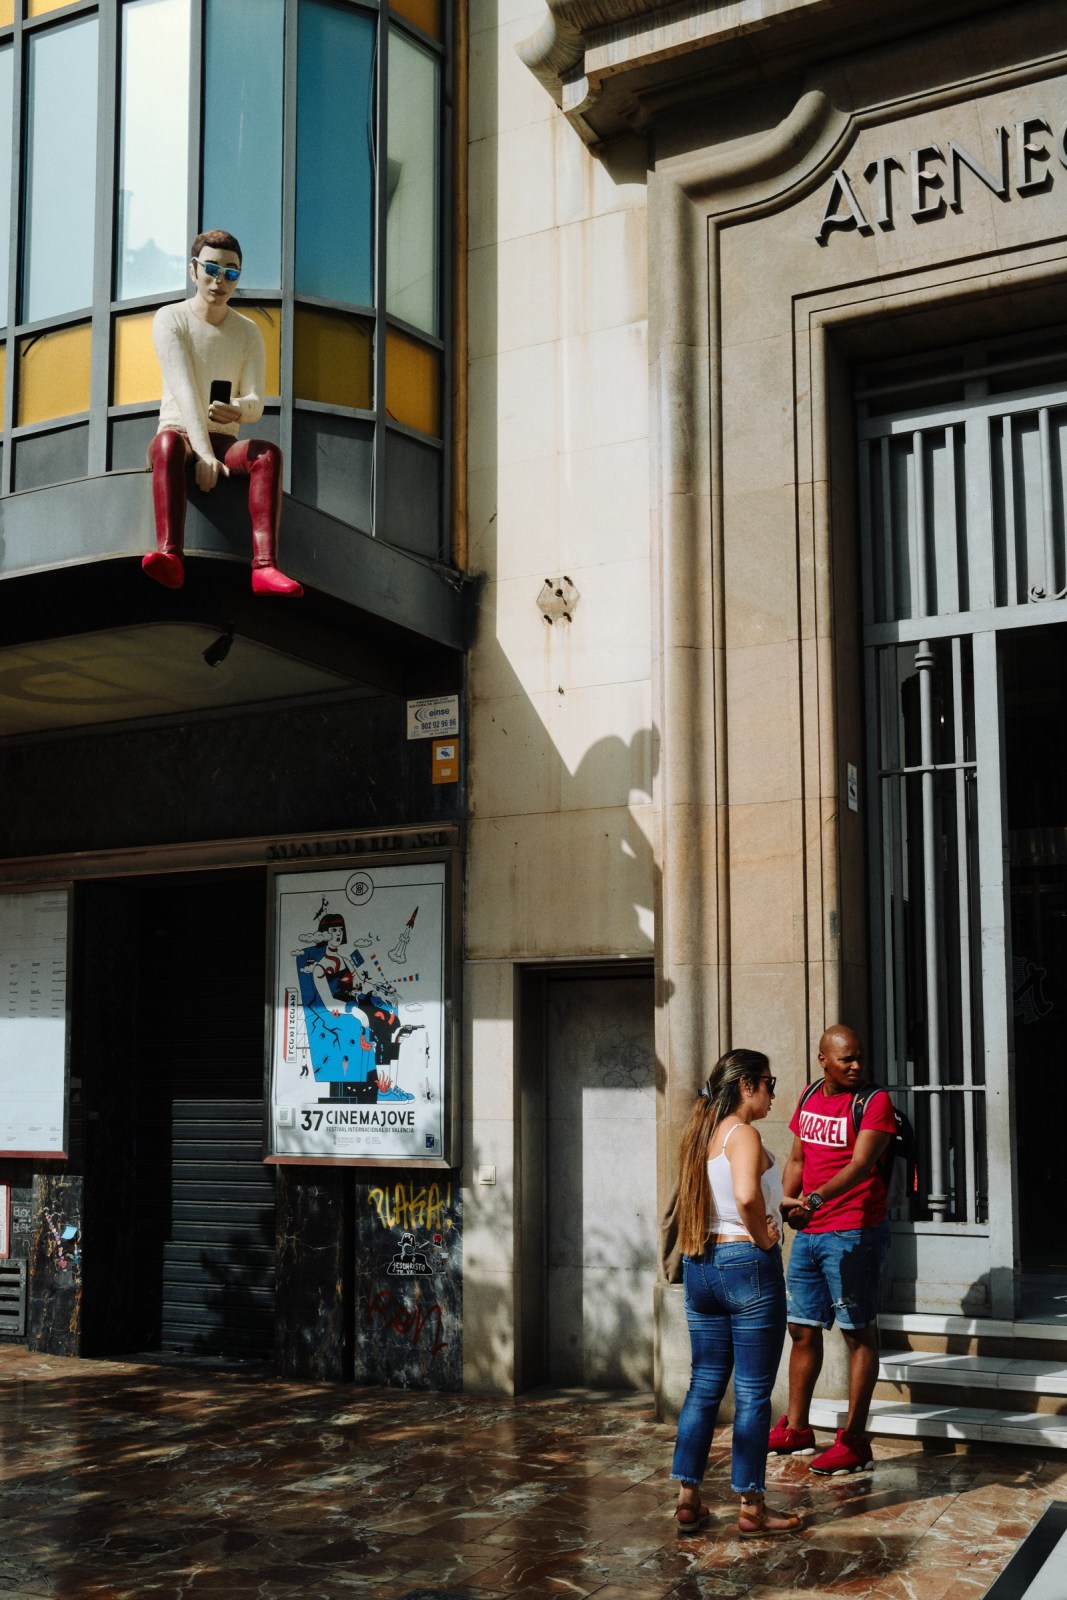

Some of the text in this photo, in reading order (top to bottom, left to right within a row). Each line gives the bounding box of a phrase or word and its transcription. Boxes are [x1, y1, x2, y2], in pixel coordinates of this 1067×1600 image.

[815, 116, 1067, 246] ATENE
[301, 1110, 323, 1131] 37
[800, 1113, 844, 1145] MARVEL
